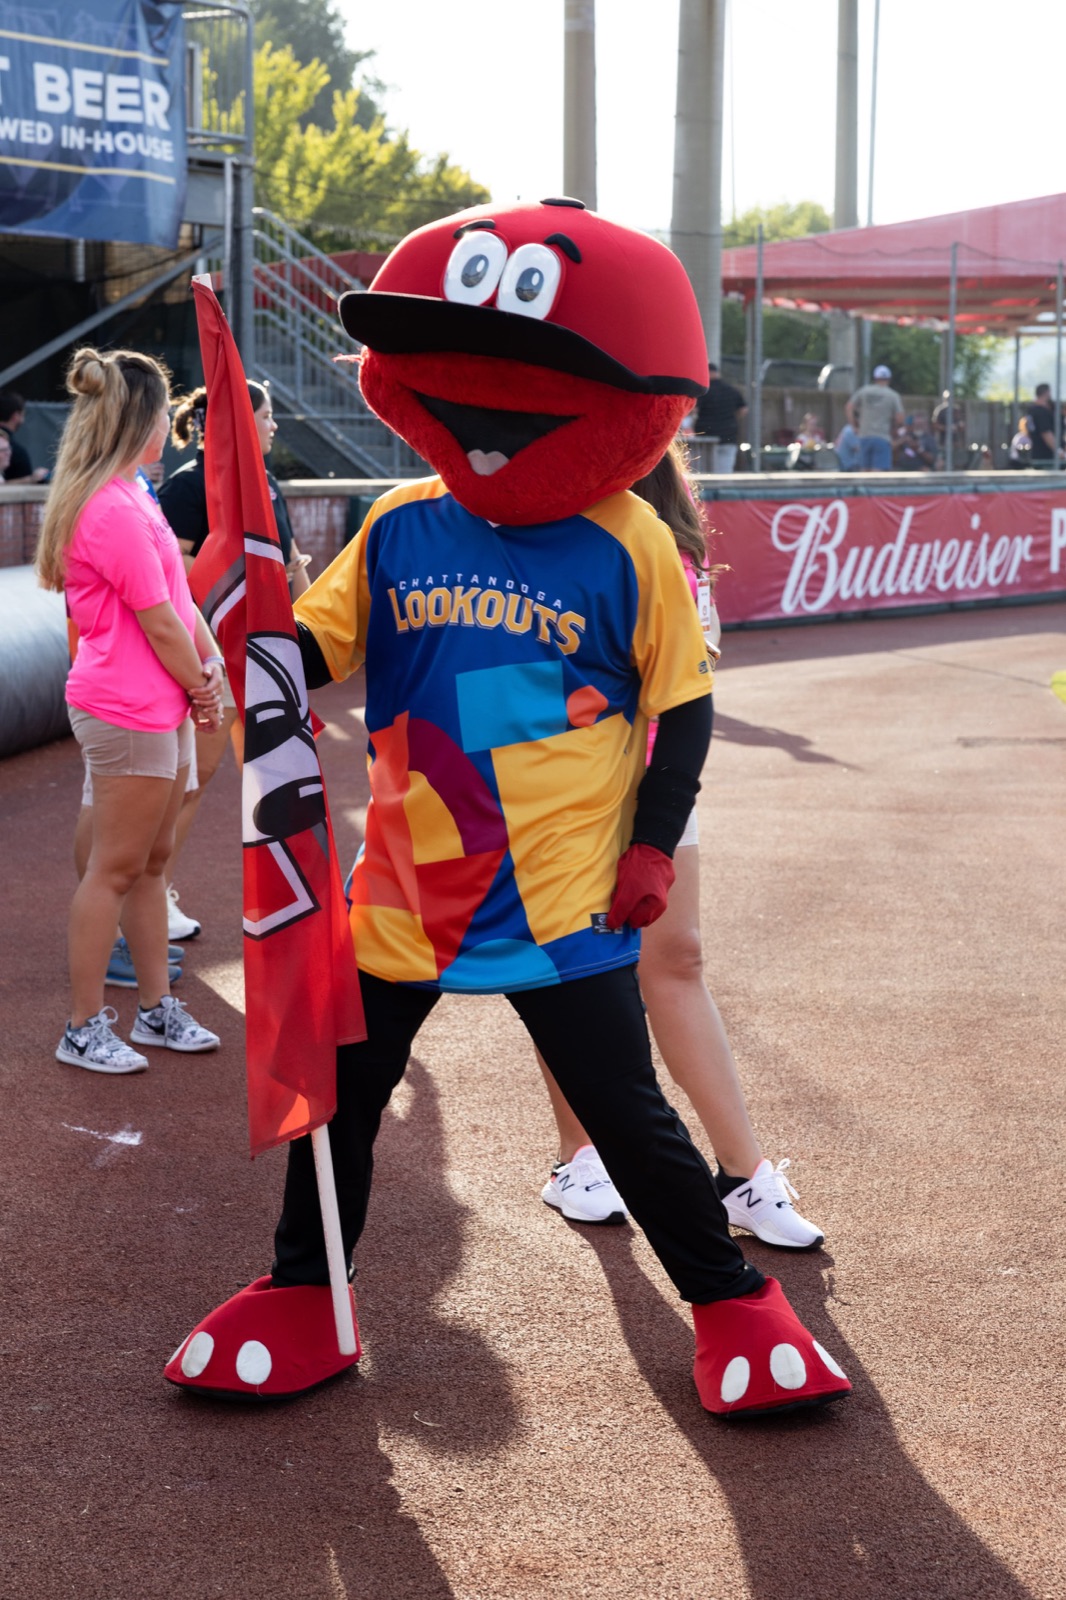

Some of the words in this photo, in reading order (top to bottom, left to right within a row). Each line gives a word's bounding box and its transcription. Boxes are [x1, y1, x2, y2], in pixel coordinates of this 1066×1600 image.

[33, 62, 171, 131] BEER
[61, 125, 175, 162] IN-HOUSE
[399, 573, 562, 609] CHATTANOOGA
[771, 499, 1033, 614] Budweiser
[387, 586, 586, 656] LOOKOUTS
